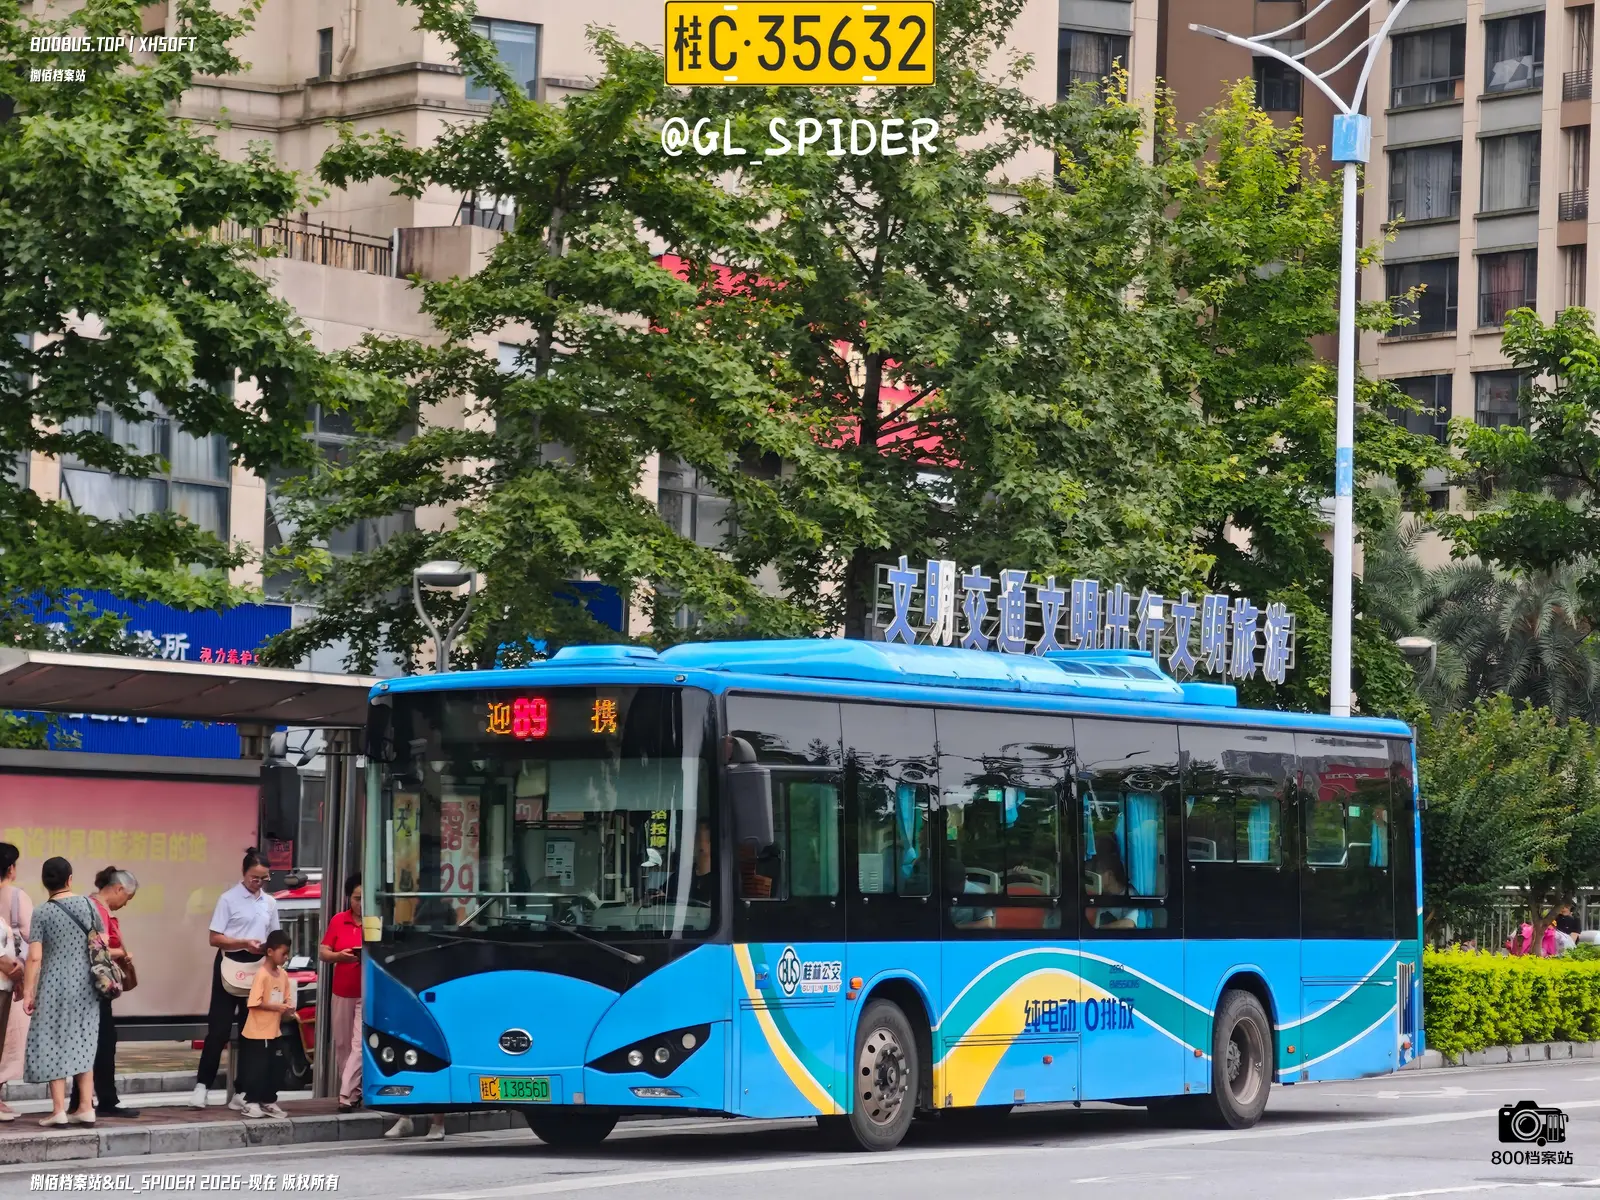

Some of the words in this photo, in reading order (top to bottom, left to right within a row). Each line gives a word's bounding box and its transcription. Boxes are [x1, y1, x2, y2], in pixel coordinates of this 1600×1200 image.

[486, 702, 512, 734] 迎
[802, 963, 841, 981] 桂林公交
[1024, 999, 1077, 1033] 纯电动
